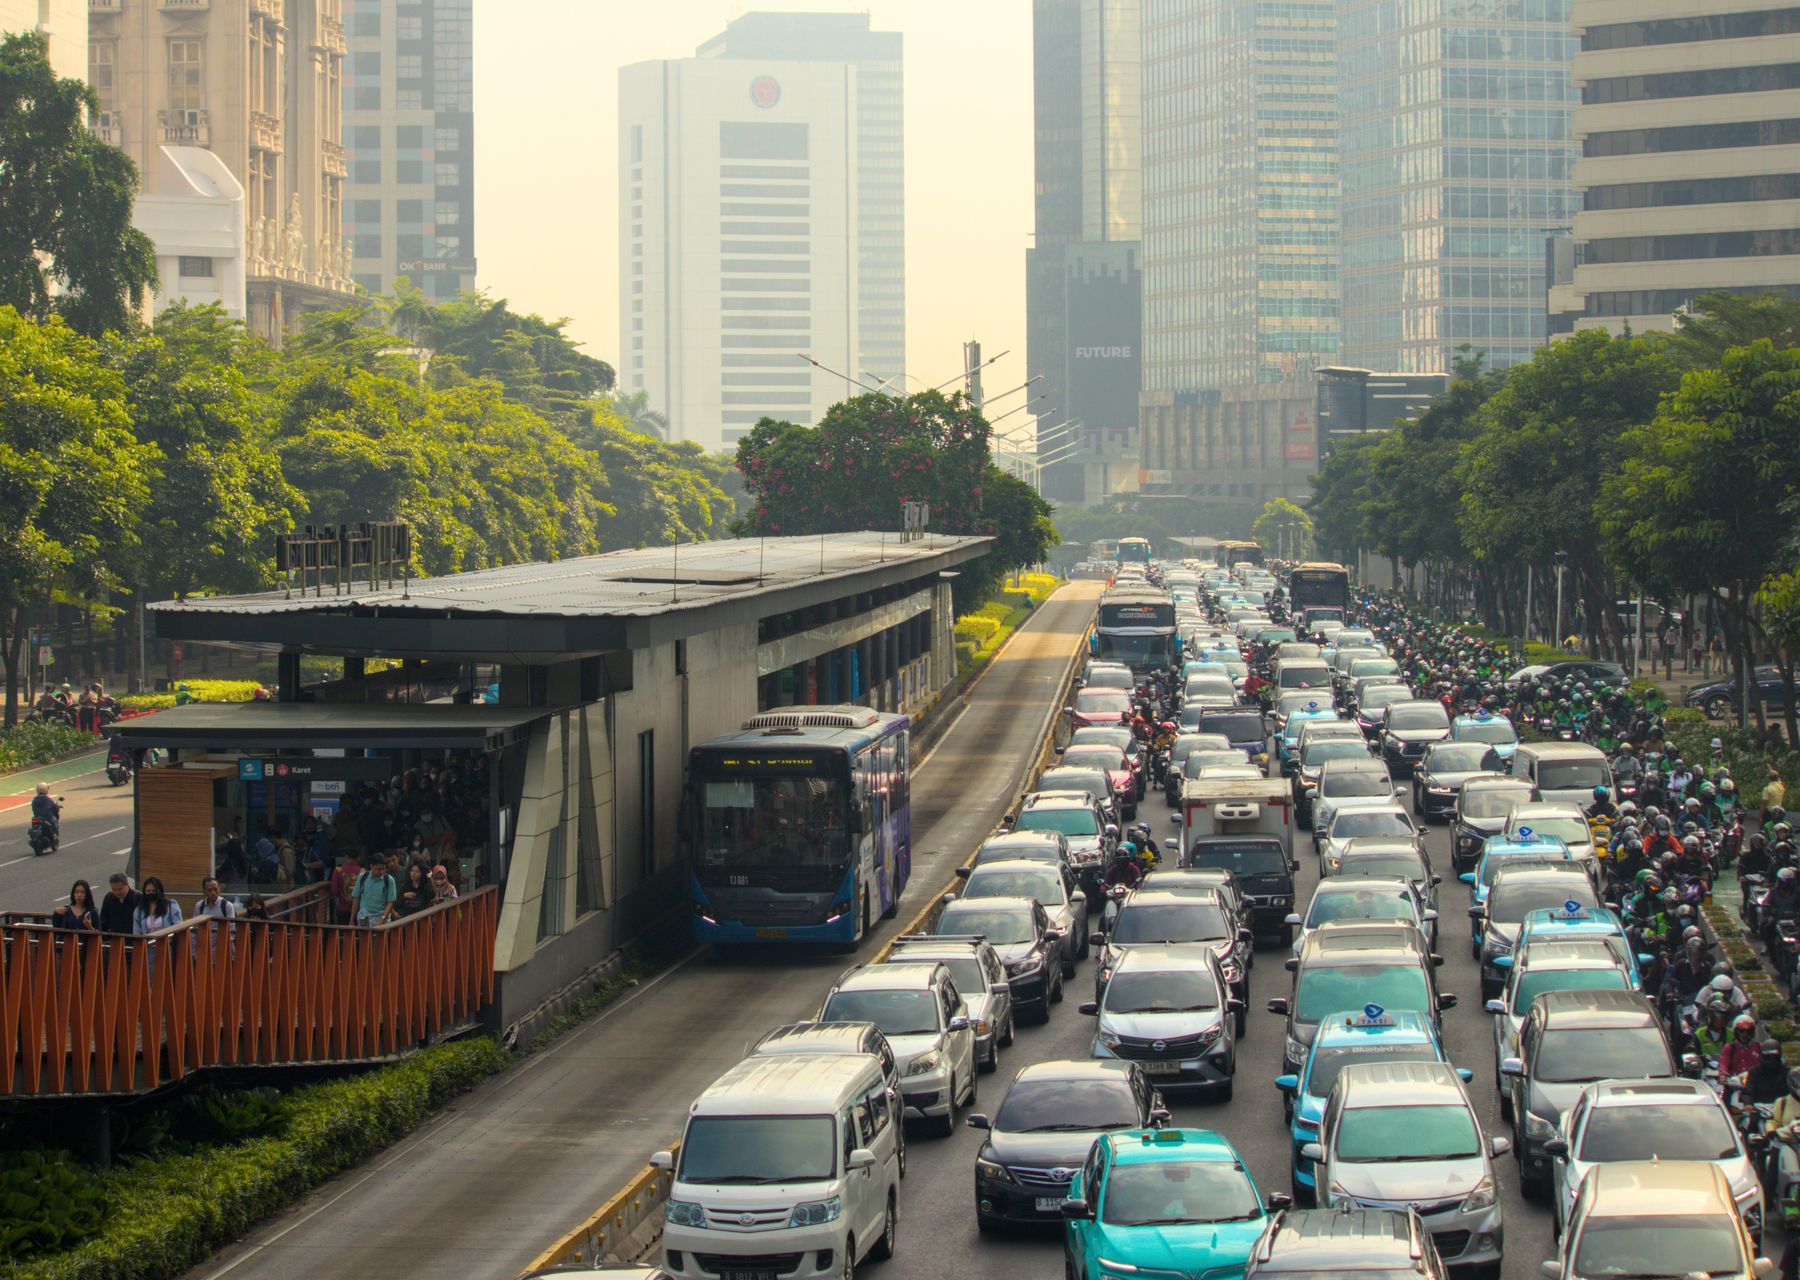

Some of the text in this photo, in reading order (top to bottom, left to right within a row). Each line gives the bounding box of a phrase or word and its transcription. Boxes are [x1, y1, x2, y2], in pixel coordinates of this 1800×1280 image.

[423, 262, 448, 271] BANK
[1075, 345, 1131, 359] FUTURE
[291, 766, 312, 775] Karet
